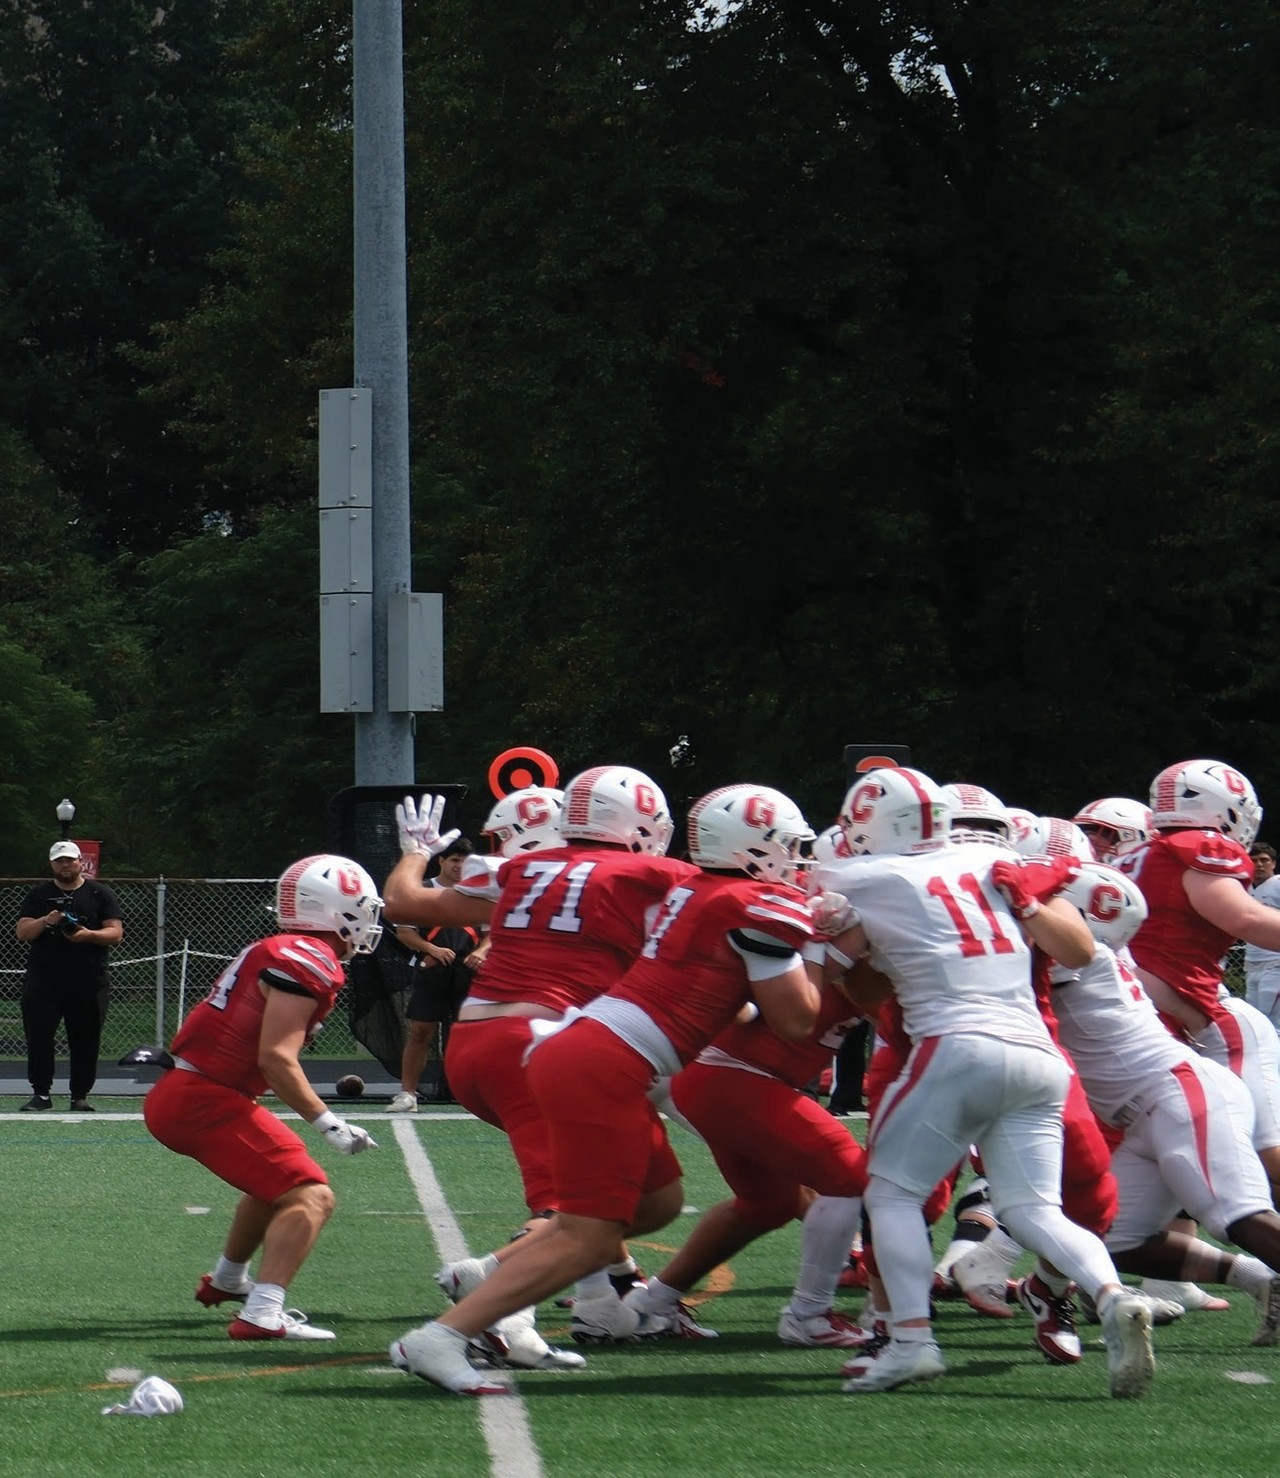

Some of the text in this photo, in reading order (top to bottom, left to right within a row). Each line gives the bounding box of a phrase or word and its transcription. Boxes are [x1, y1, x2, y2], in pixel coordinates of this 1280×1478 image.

[515, 795, 551, 829] C
[634, 783, 657, 816] G
[744, 796, 776, 829] G
[851, 782, 881, 824] C
[337, 867, 363, 896] G
[502, 860, 598, 933] 71
[926, 872, 1016, 958] 11
[1088, 883, 1124, 923] C
